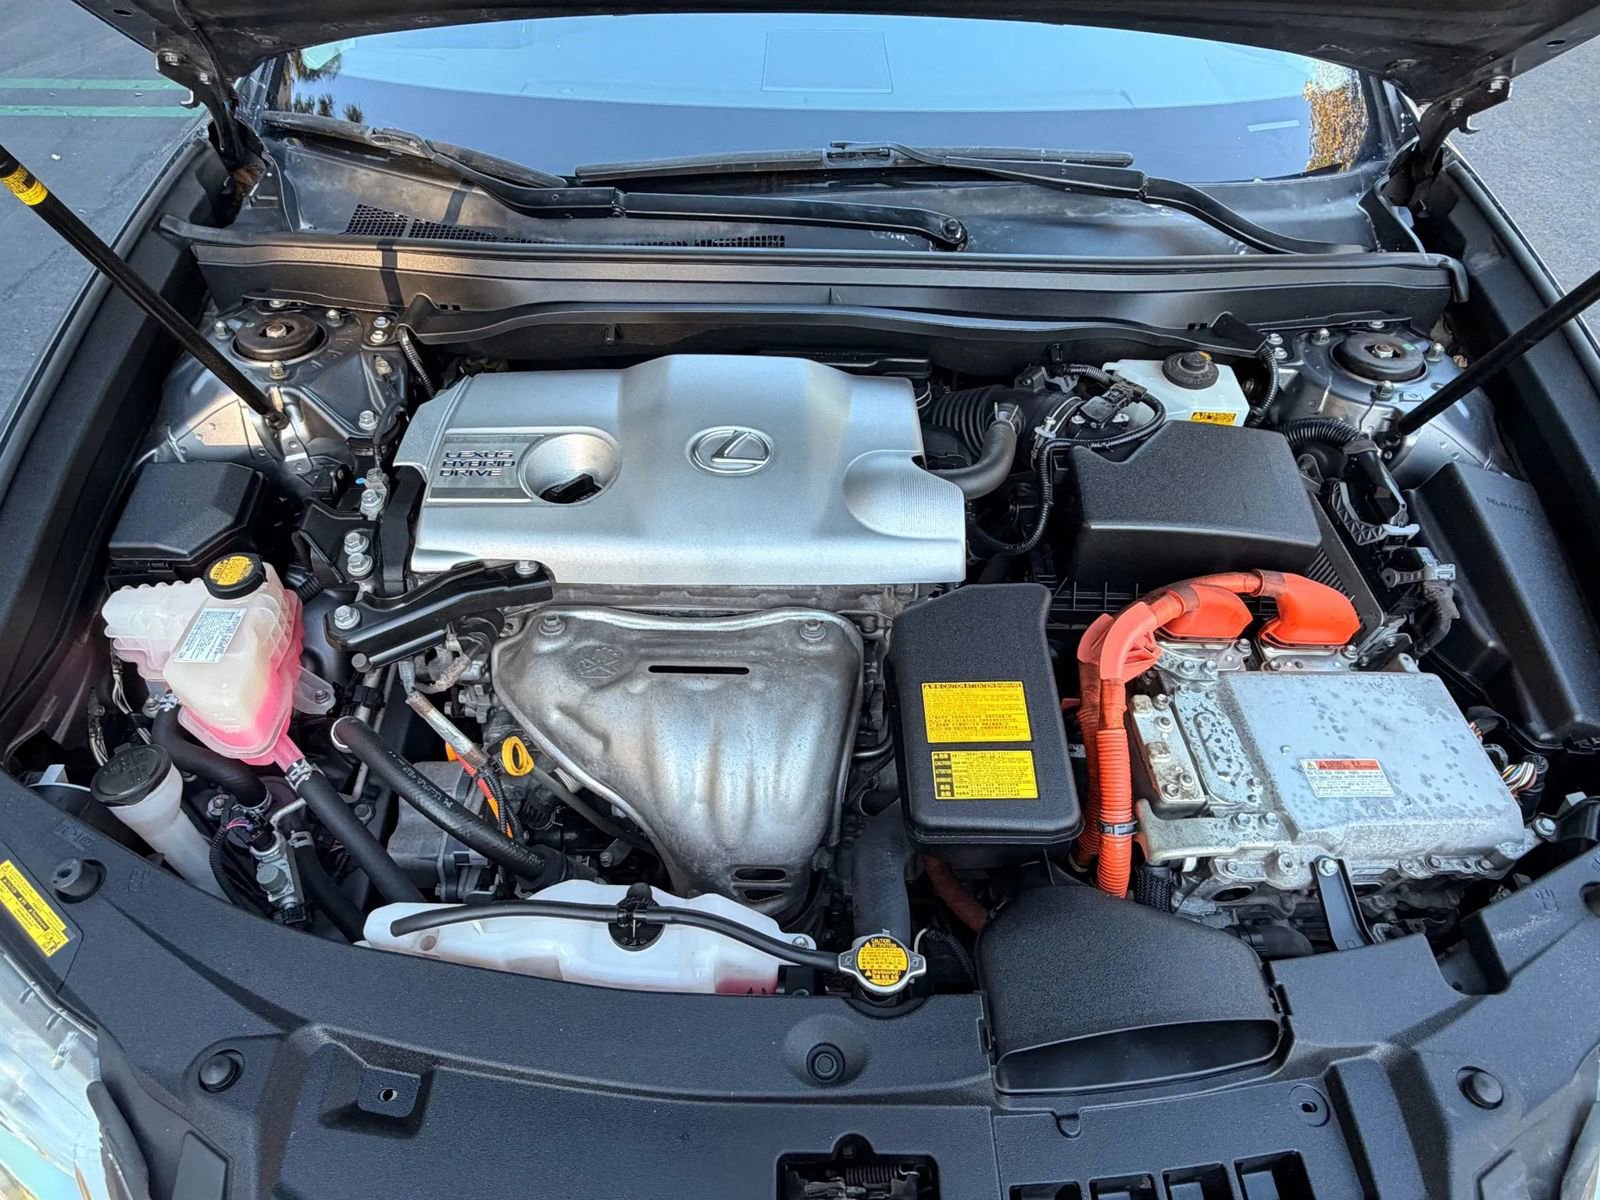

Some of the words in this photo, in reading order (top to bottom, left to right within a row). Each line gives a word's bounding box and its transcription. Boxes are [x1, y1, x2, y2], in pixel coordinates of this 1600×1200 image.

[445, 450, 514, 458] LEXUS
[442, 459, 516, 467] HYBRID
[439, 468, 502, 477] DRIVE
